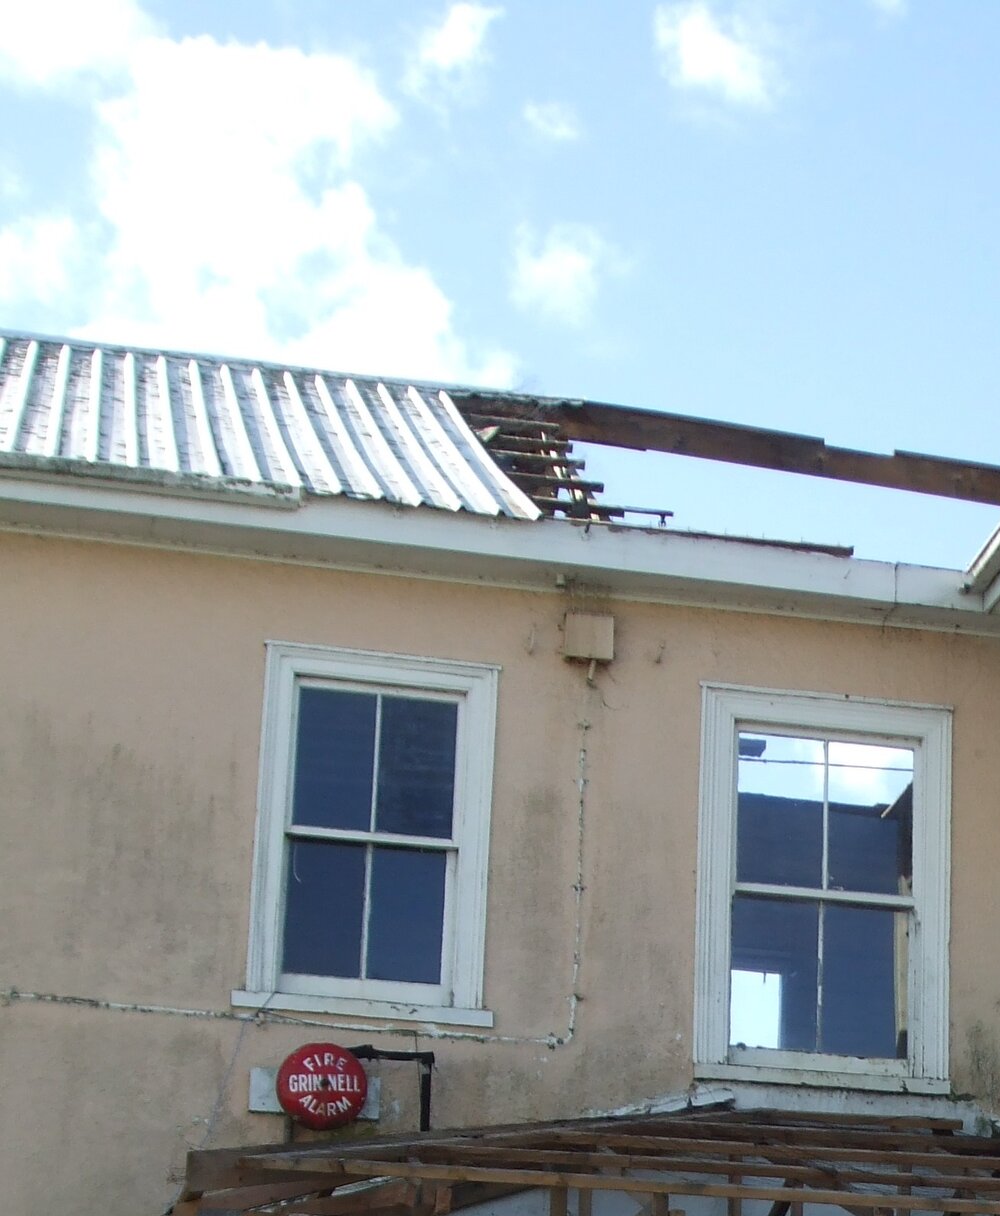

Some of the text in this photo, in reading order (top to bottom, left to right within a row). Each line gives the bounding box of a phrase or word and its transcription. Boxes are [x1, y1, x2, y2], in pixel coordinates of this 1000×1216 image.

[302, 1052, 348, 1072] FIRE
[288, 1073, 361, 1093] GRINNELL
[299, 1094, 352, 1117] ALARM
